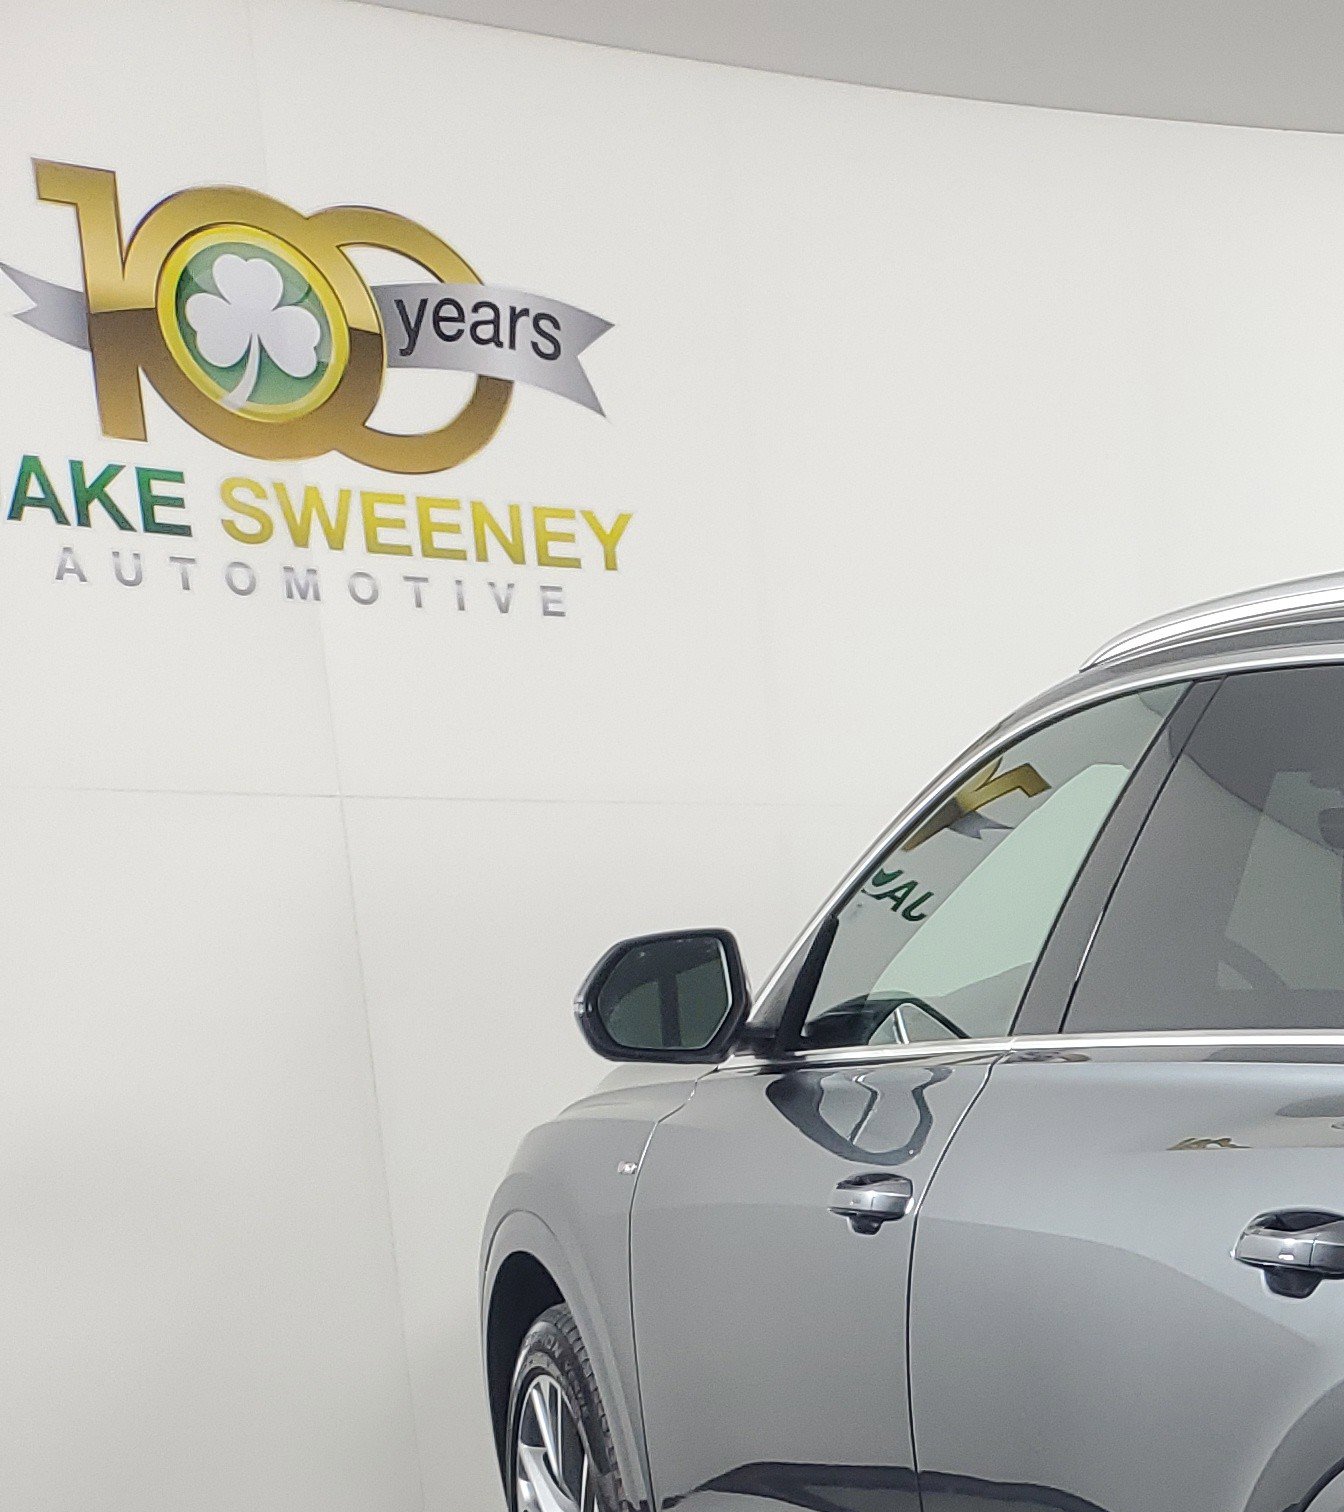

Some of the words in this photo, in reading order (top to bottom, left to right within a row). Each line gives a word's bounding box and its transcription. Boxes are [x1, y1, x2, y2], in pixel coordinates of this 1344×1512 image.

[31, 157, 514, 474] 100
[394, 296, 562, 361] years
[7, 455, 193, 537] AKE
[219, 477, 633, 571] SWEENEY
[55, 546, 567, 617] AUTOMOTIVE
